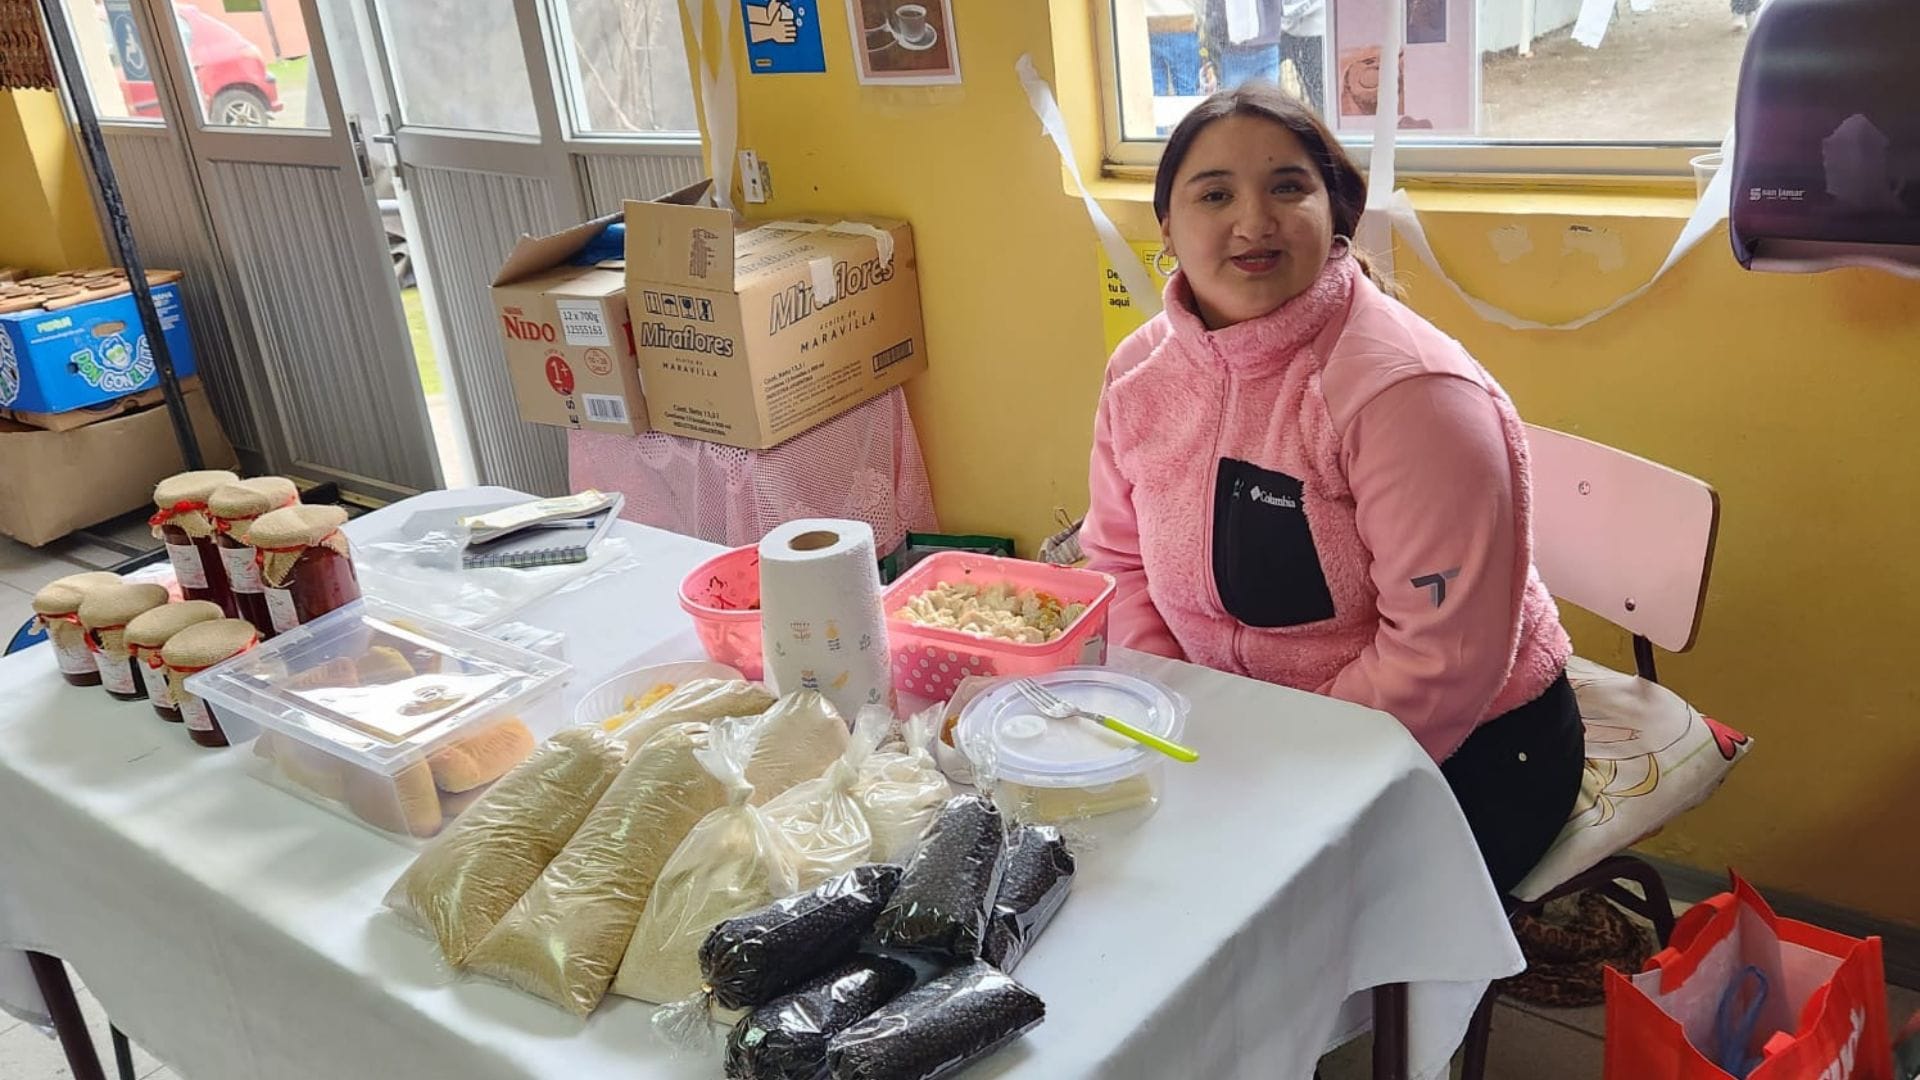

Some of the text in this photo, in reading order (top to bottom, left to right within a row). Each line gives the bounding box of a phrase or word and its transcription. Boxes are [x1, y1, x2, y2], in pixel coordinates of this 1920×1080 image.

[1108, 283, 1119, 293] tu
[563, 311, 572, 321] 12
[579, 312, 600, 324] 700g
[502, 314, 556, 342] NIDO
[800, 312, 876, 353] MARAVILLA
[641, 322, 734, 358] Miraflores
[662, 362, 719, 378] MARAVILLA
[1260, 490, 1296, 508] Columbia
